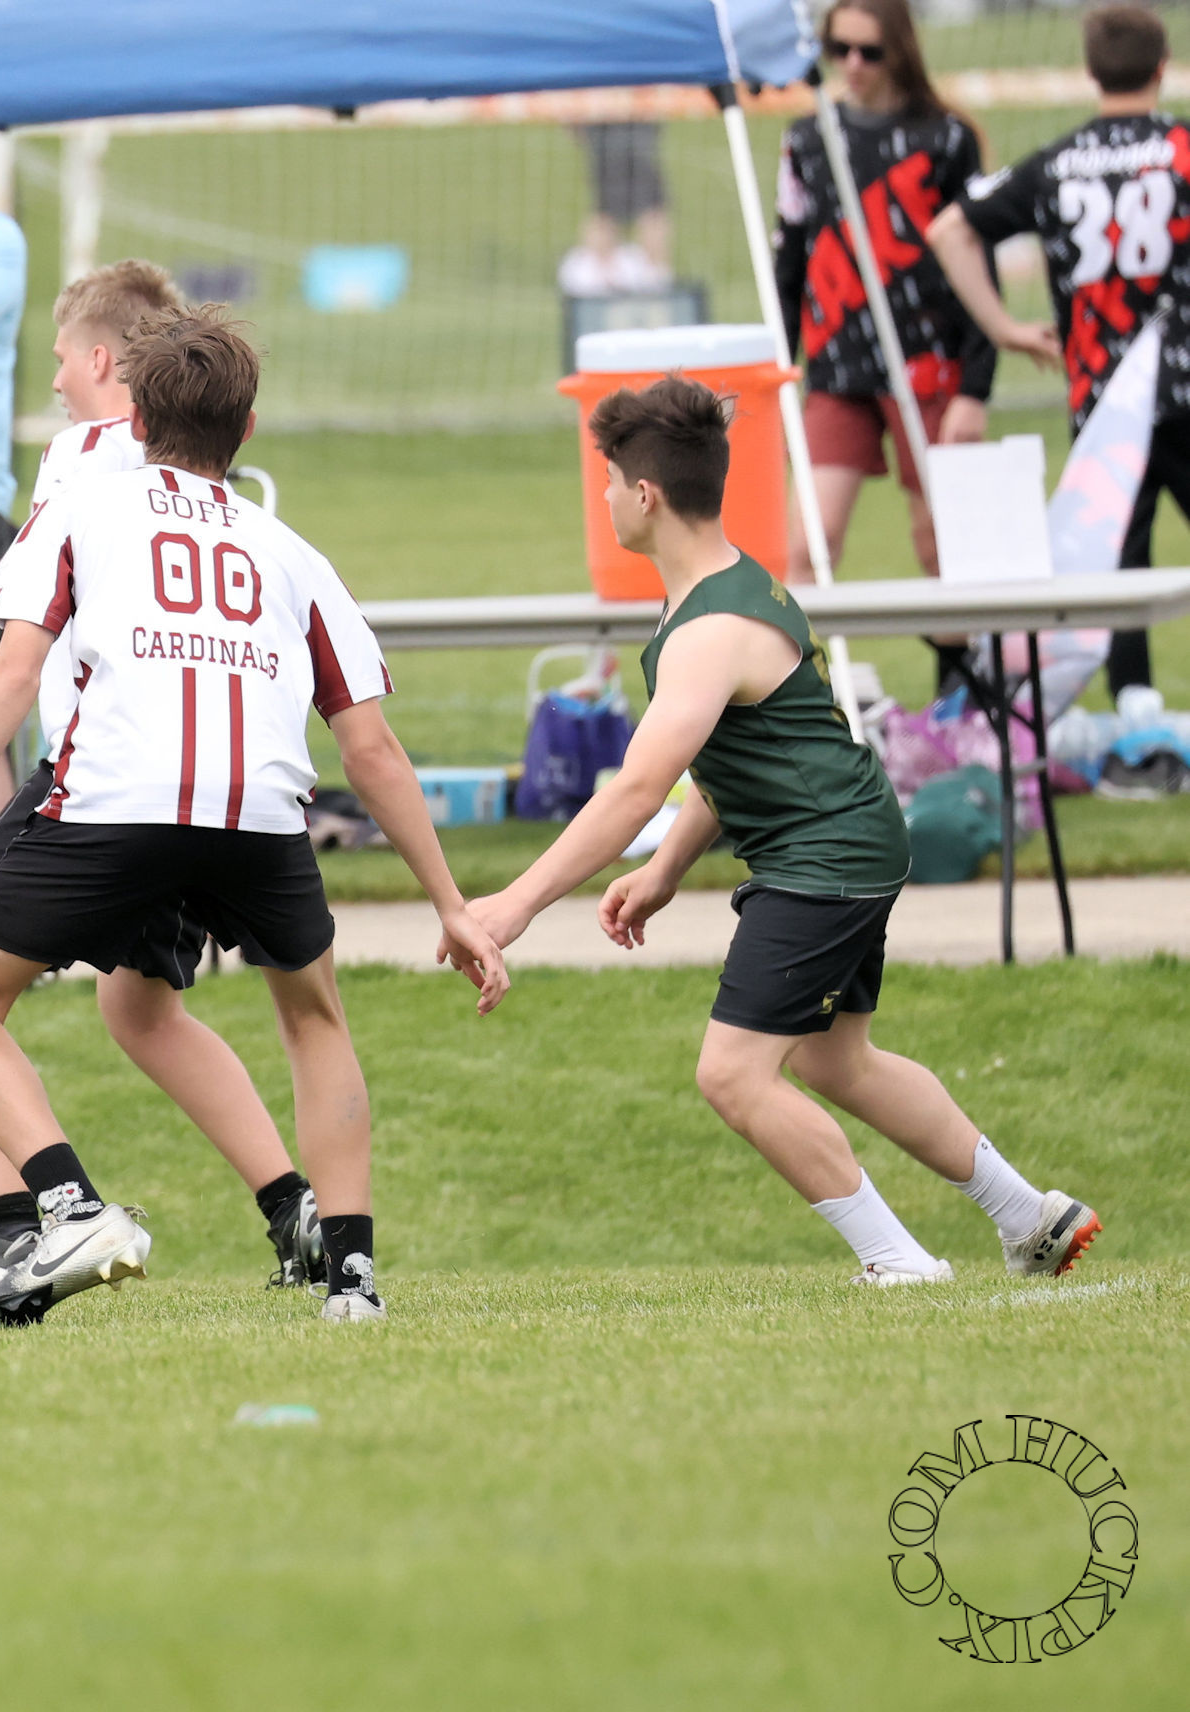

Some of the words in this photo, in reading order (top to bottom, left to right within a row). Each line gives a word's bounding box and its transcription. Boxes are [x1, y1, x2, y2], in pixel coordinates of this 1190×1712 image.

[1057, 168, 1177, 288] 38
[147, 488, 240, 528] GOFF
[150, 530, 263, 627] 00
[132, 626, 279, 681] CARDINALS
